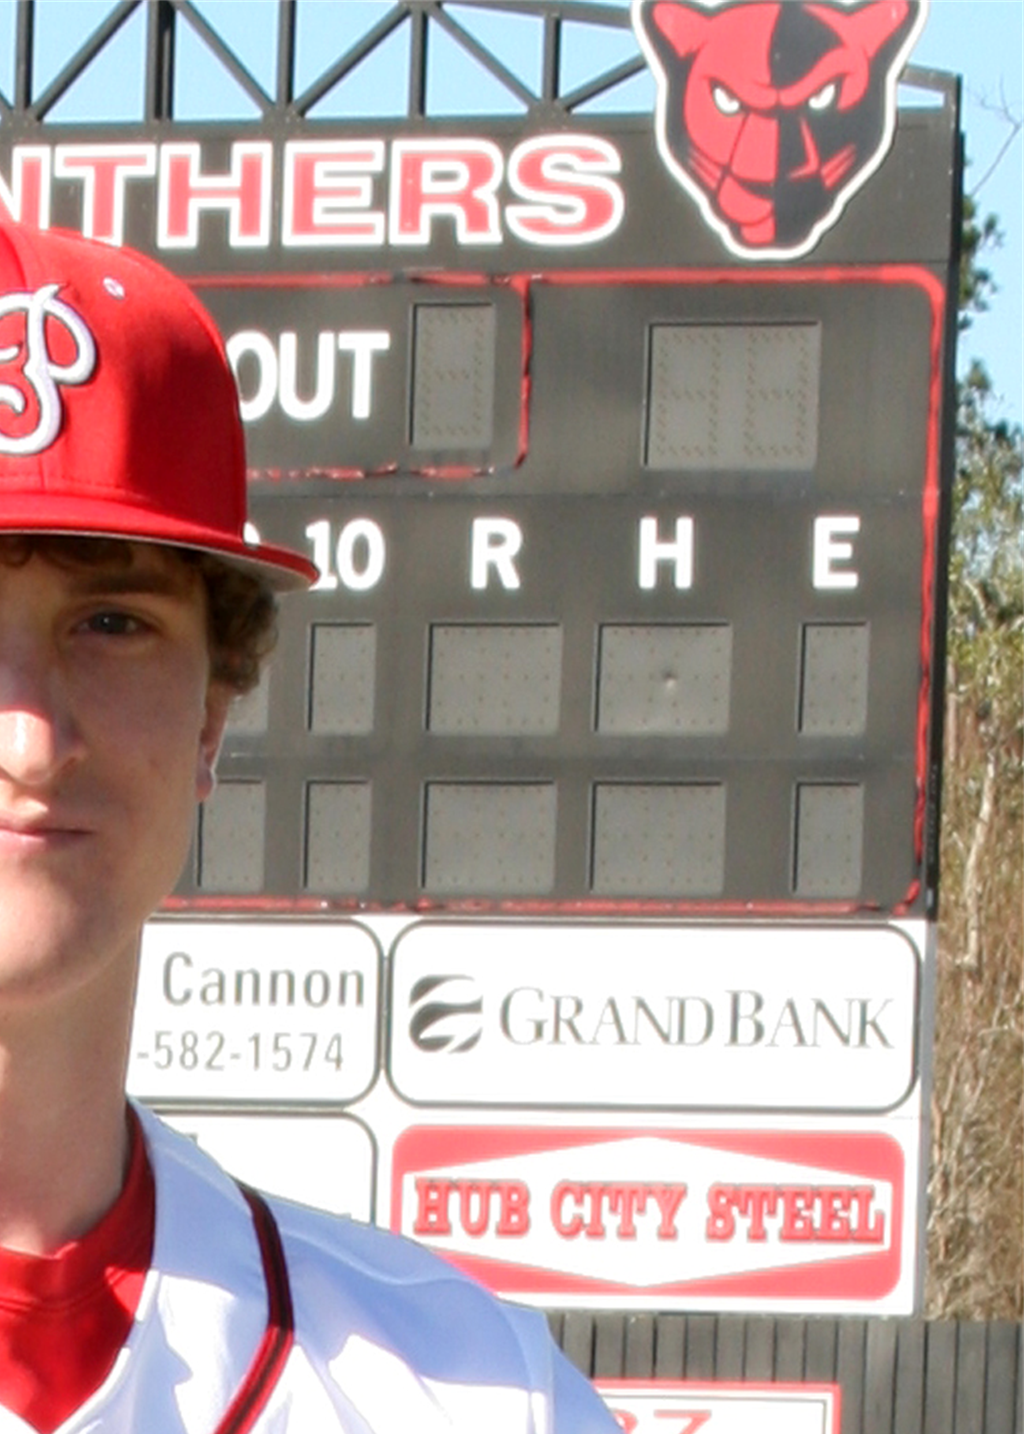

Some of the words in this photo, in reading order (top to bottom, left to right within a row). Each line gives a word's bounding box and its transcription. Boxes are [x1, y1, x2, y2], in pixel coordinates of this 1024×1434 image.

[226, 330, 391, 422] OUT
[305, 517, 386, 591] 10
[470, 517, 524, 591] R
[638, 517, 694, 590] H
[812, 516, 861, 590] E
[163, 951, 365, 1008] Cannon
[499, 986, 715, 1047] GRAND
[728, 989, 895, 1050] BANK
[414, 1178, 532, 1237] HUB
[549, 1181, 688, 1240] CITY
[705, 1183, 886, 1244] STEEL
